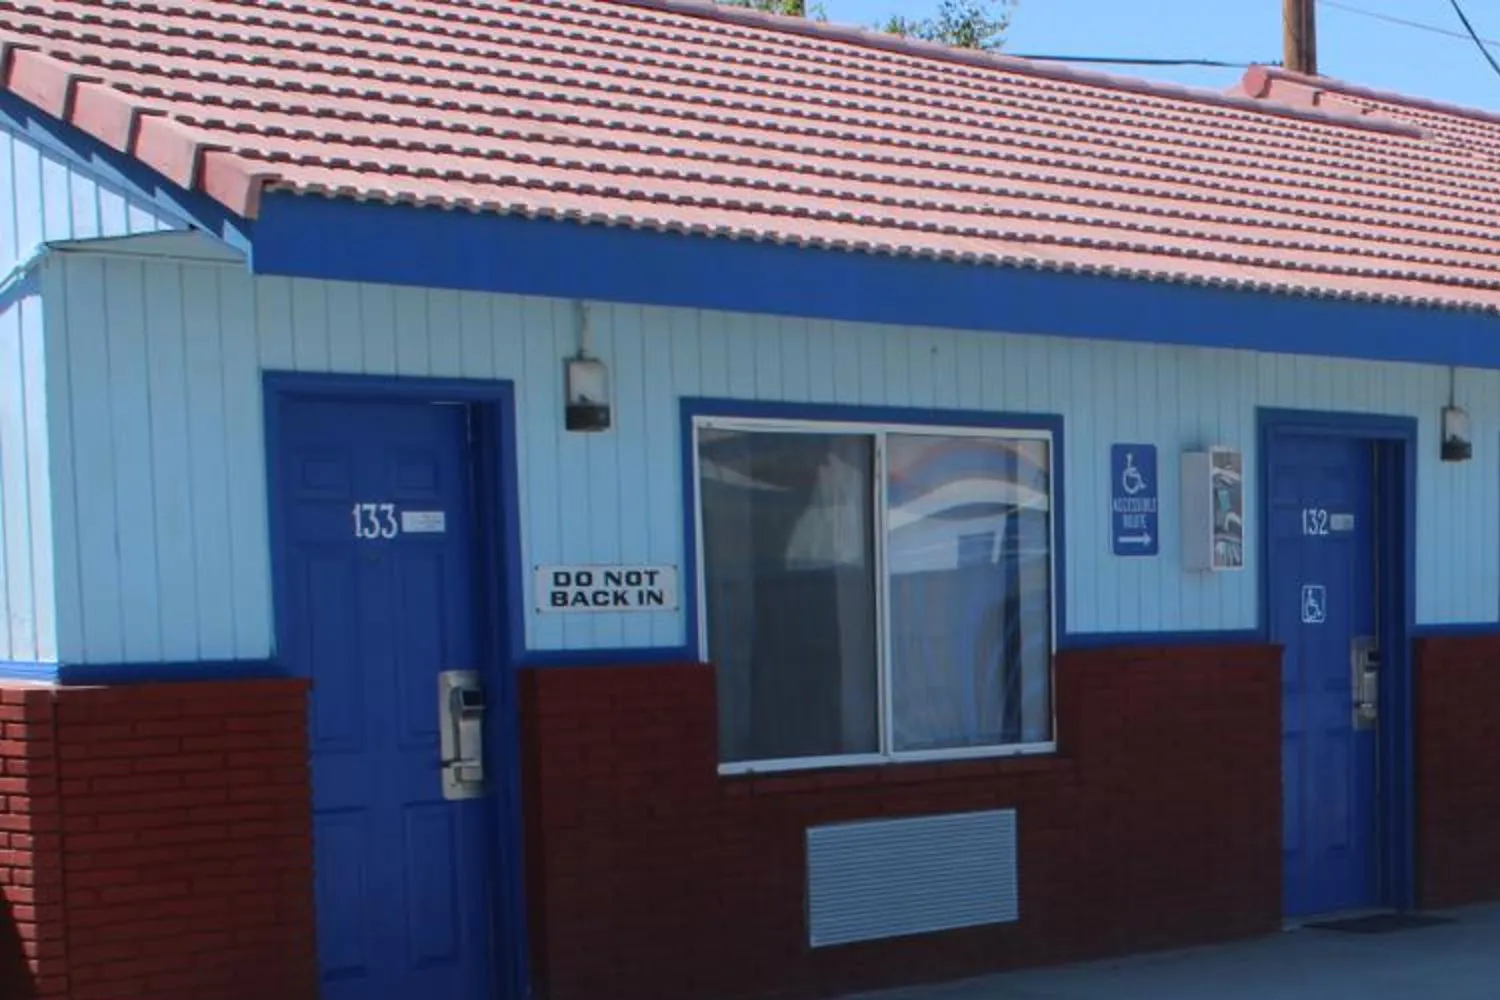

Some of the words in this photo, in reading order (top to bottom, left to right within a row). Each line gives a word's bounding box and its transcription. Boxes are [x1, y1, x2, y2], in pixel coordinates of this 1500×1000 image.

[352, 503, 398, 539] 133
[1302, 508, 1328, 535] 132
[552, 571, 593, 587] DO
[604, 570, 659, 587] NOT
[550, 590, 630, 607] BACK
[638, 589, 664, 606] IN
